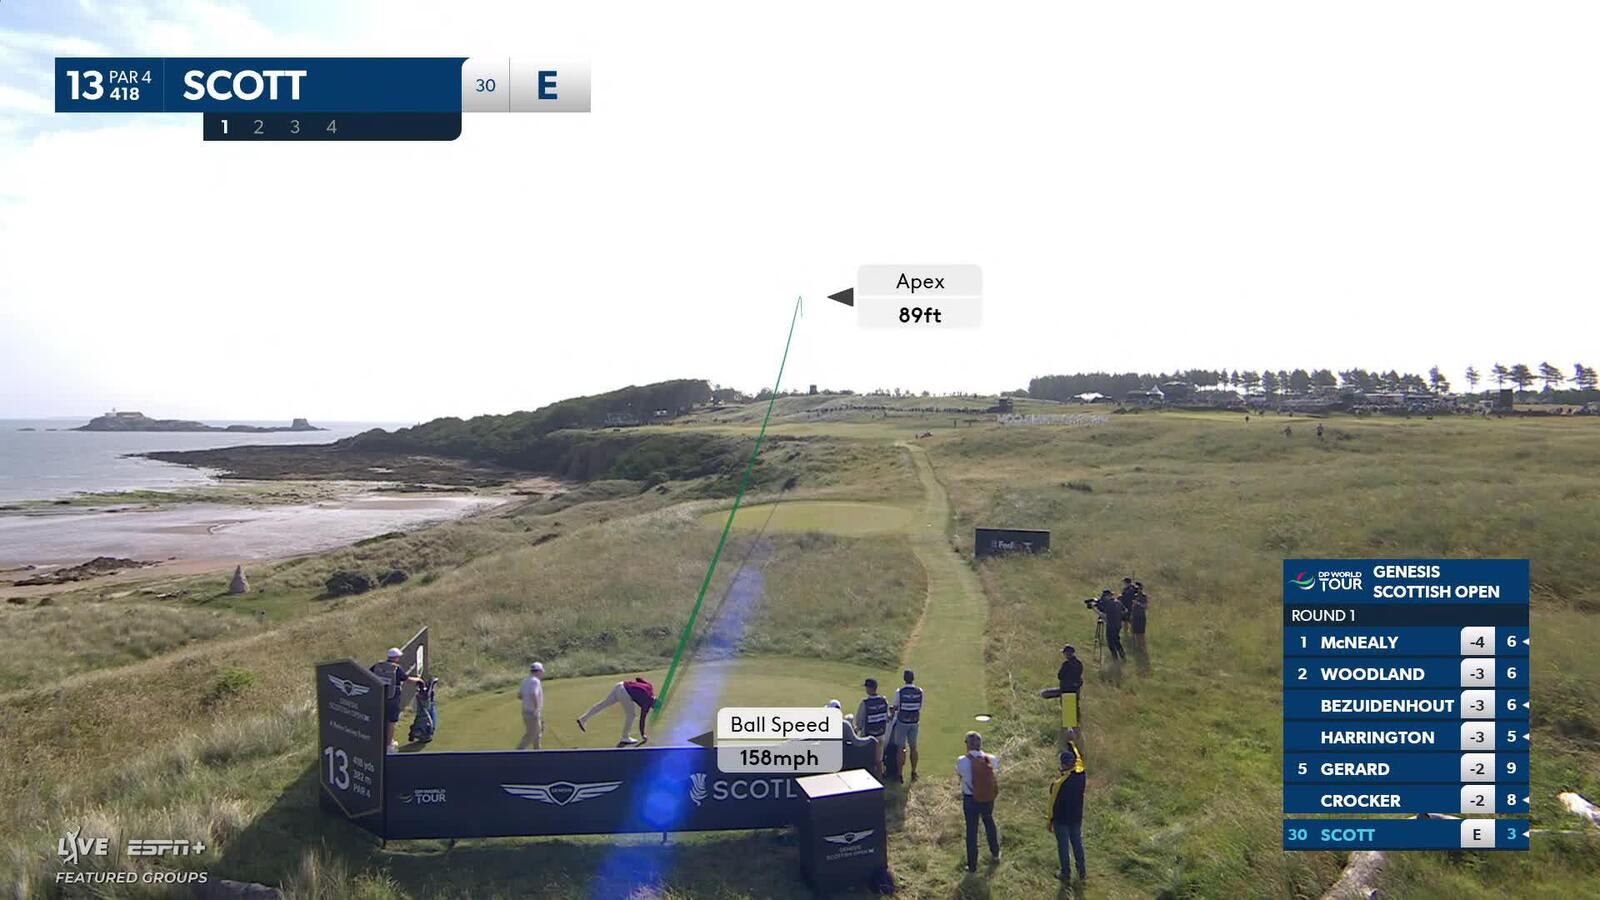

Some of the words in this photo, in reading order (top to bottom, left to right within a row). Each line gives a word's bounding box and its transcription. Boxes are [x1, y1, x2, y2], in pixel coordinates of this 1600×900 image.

[324, 746, 350, 790] 13
[415, 794, 446, 804] TOUR
[713, 779, 798, 800] SCOTL
